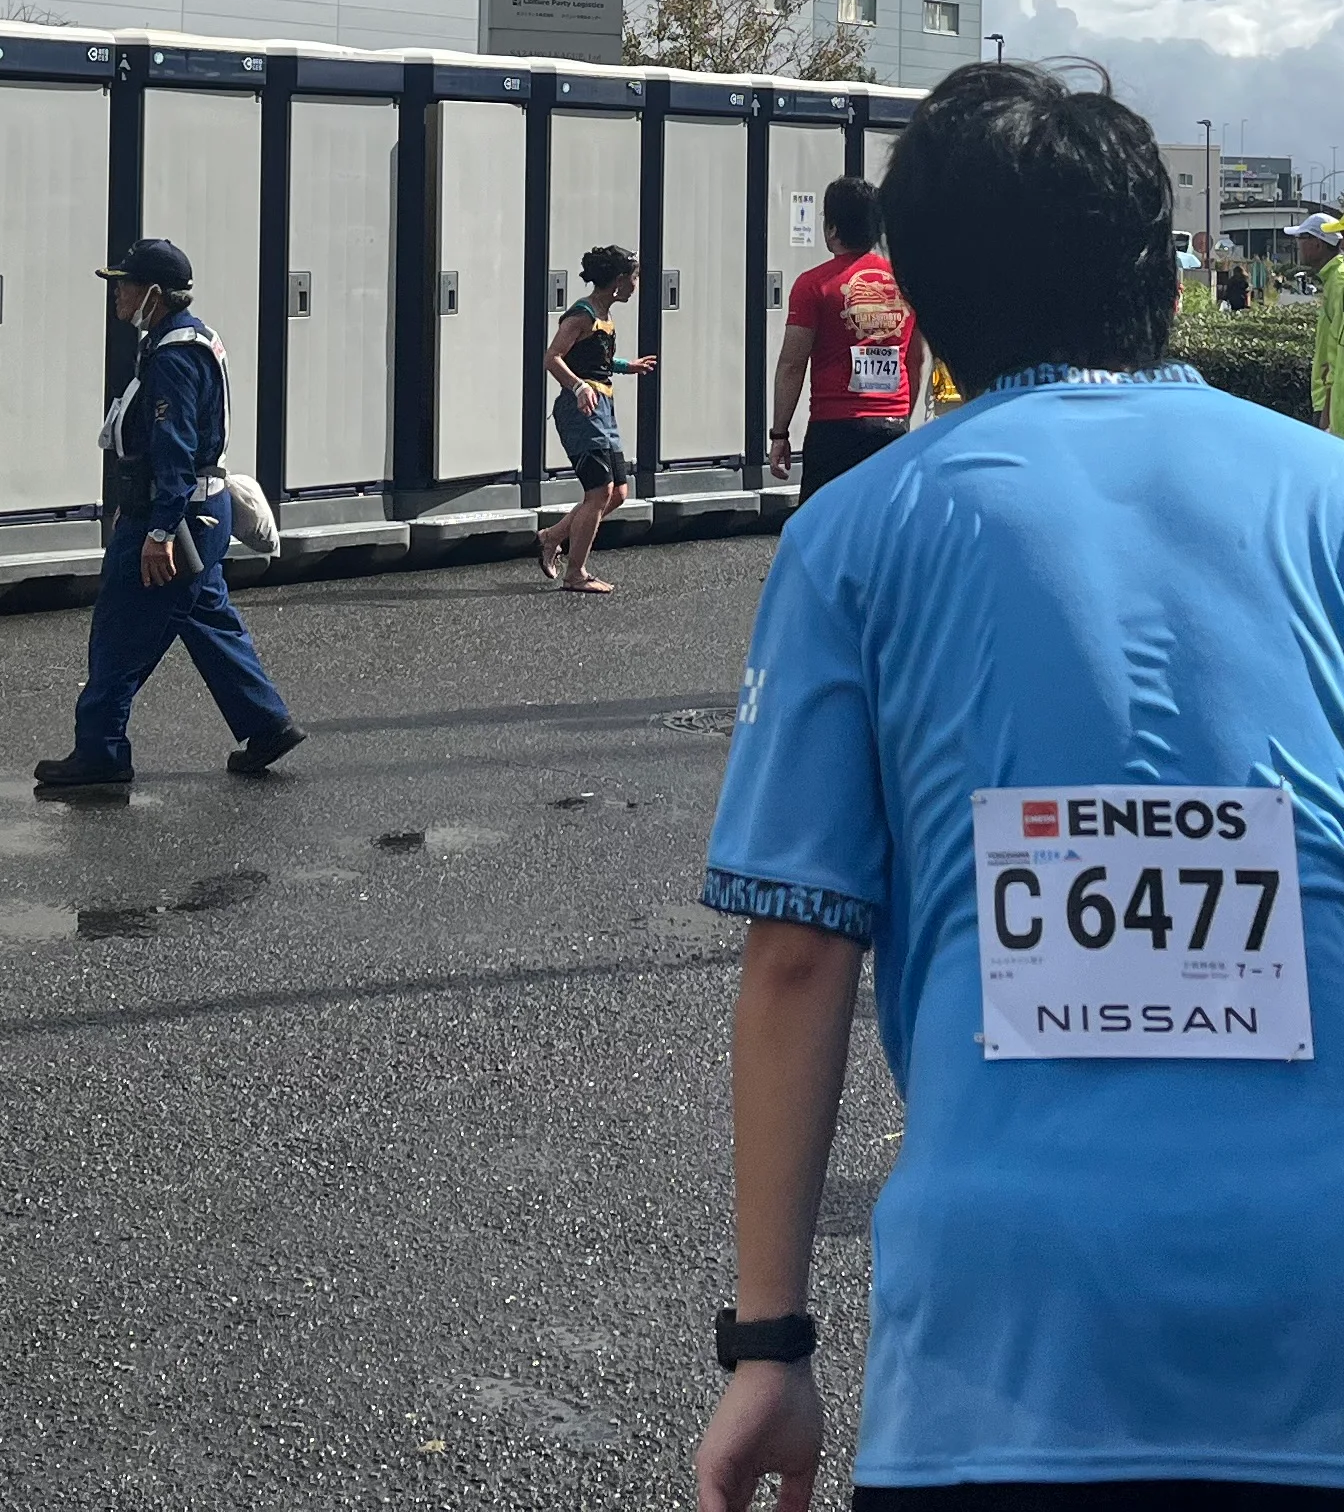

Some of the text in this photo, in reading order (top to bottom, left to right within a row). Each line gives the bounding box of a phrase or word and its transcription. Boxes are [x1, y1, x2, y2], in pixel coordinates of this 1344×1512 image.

[854, 359, 898, 376] D11747
[1066, 798, 1248, 841] ENEOS
[993, 865, 1281, 953] C 6477
[1036, 1004, 1259, 1035] NISSAN
